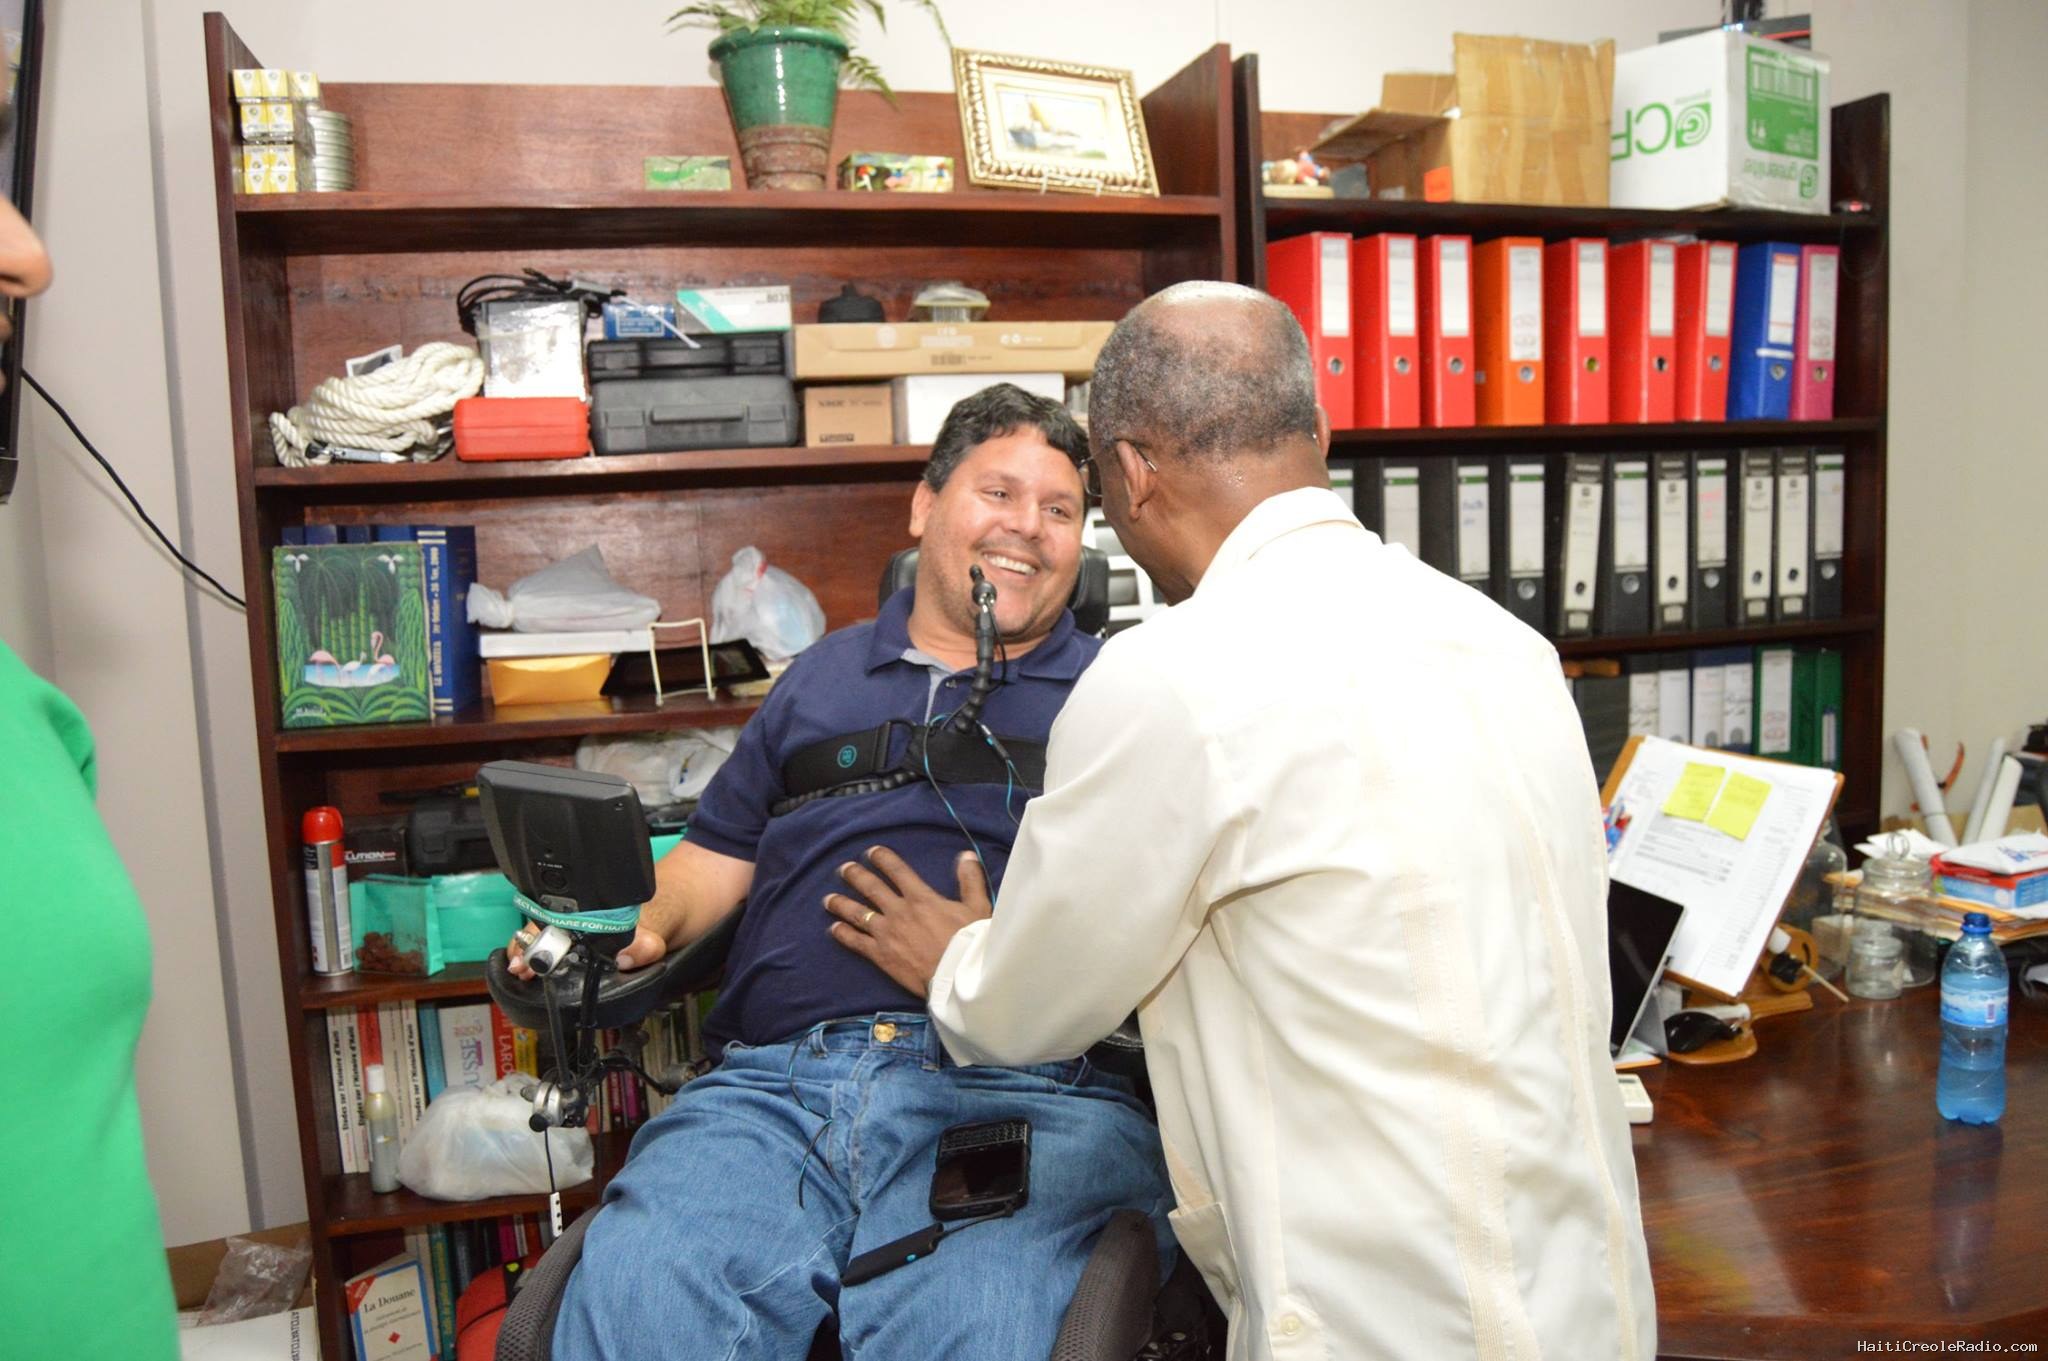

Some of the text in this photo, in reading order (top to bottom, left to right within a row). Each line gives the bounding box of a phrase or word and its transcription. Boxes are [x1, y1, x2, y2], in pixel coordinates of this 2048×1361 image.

[582, 921, 603, 931] FOR
[461, 1038, 482, 1090] USSE
[364, 1303, 376, 1313] La
[378, 1289, 416, 1308] Douane
